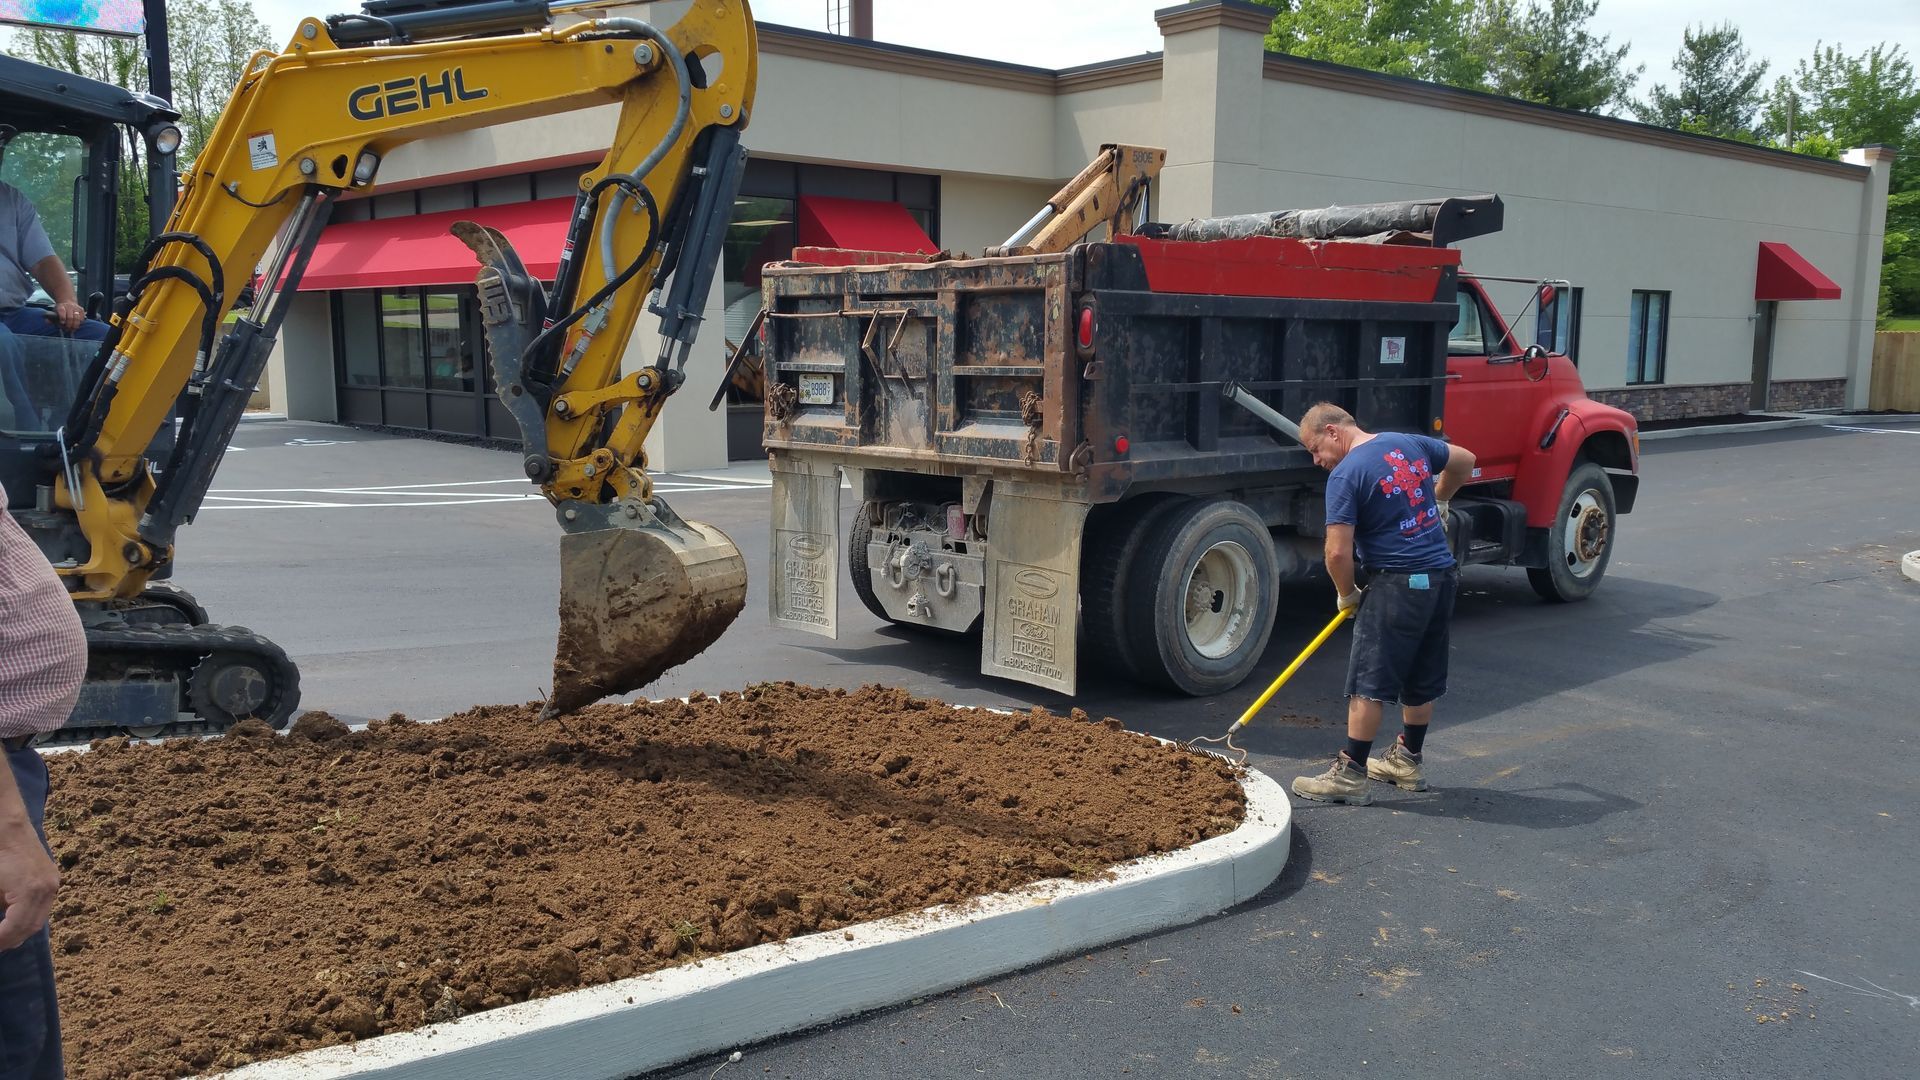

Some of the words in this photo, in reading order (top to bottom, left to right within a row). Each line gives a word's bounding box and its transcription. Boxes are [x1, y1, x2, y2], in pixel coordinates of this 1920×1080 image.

[348, 66, 489, 121] GEHL
[784, 559, 828, 580] GRAHAM
[791, 595, 823, 611] TRUCKS
[1008, 598, 1061, 625] GRAHAM
[1013, 640, 1054, 660] TRUCKS
